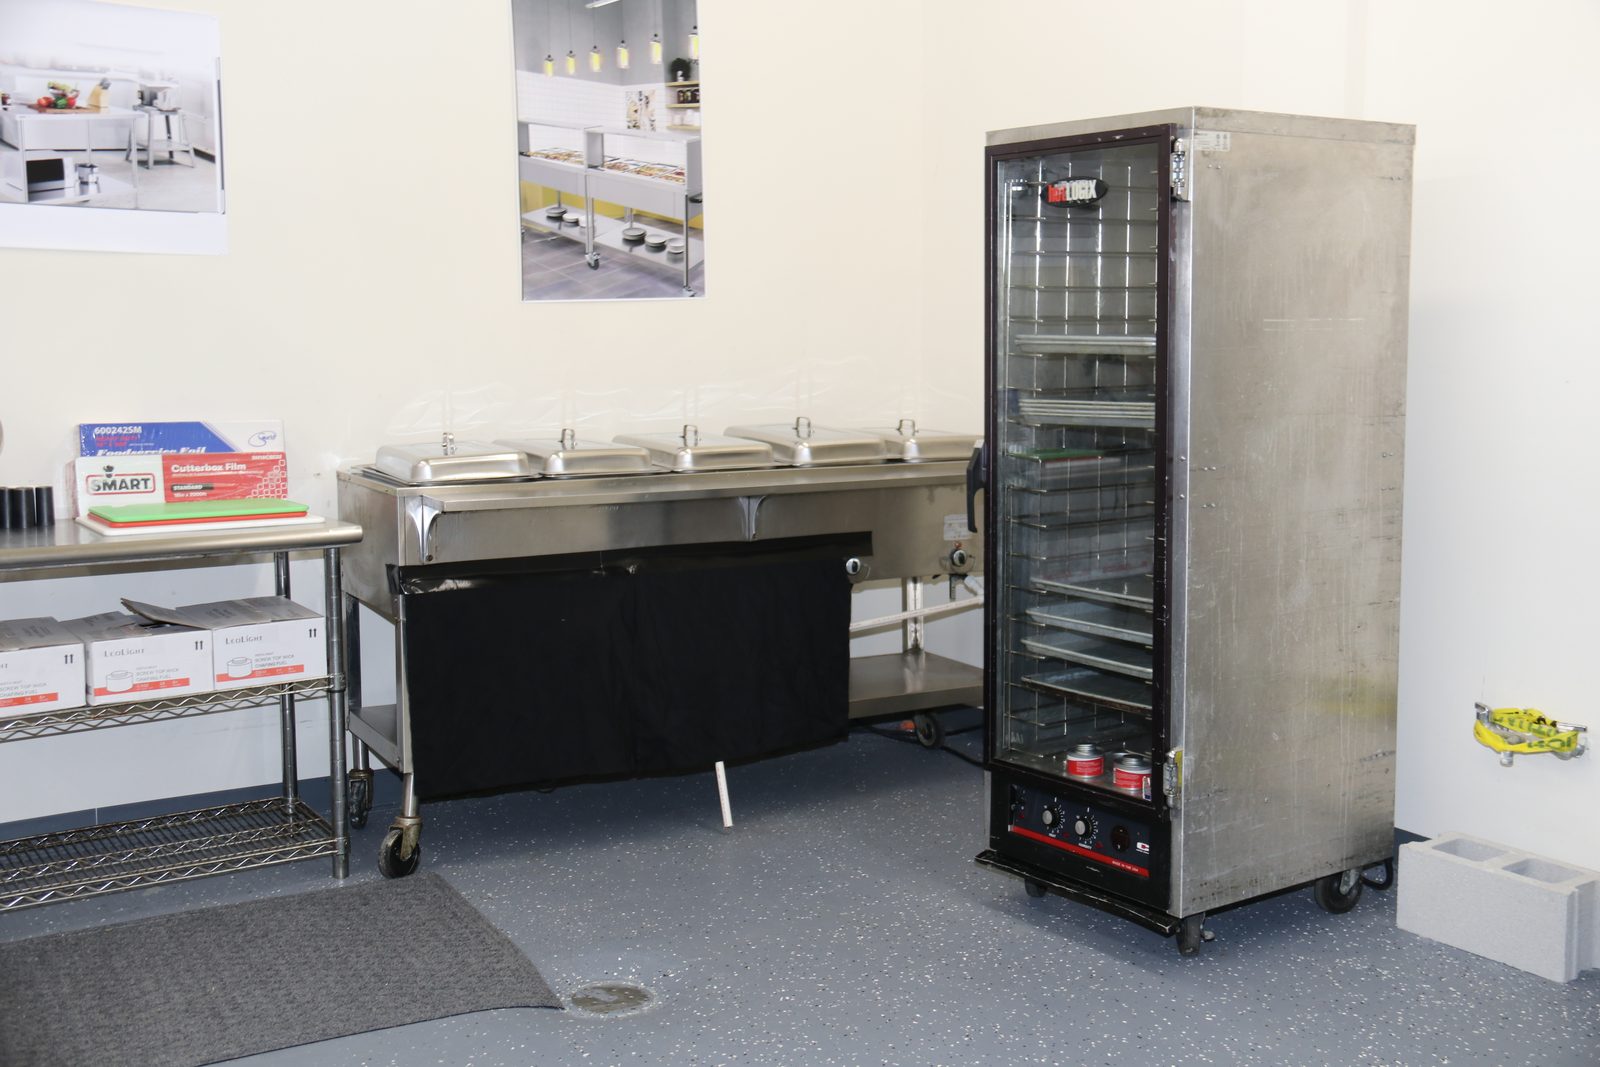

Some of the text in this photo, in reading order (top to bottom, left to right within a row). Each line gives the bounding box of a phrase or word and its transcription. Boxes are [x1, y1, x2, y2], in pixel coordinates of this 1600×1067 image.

[171, 462, 246, 473] Cutterbox Film
[89, 477, 152, 492] SMART
